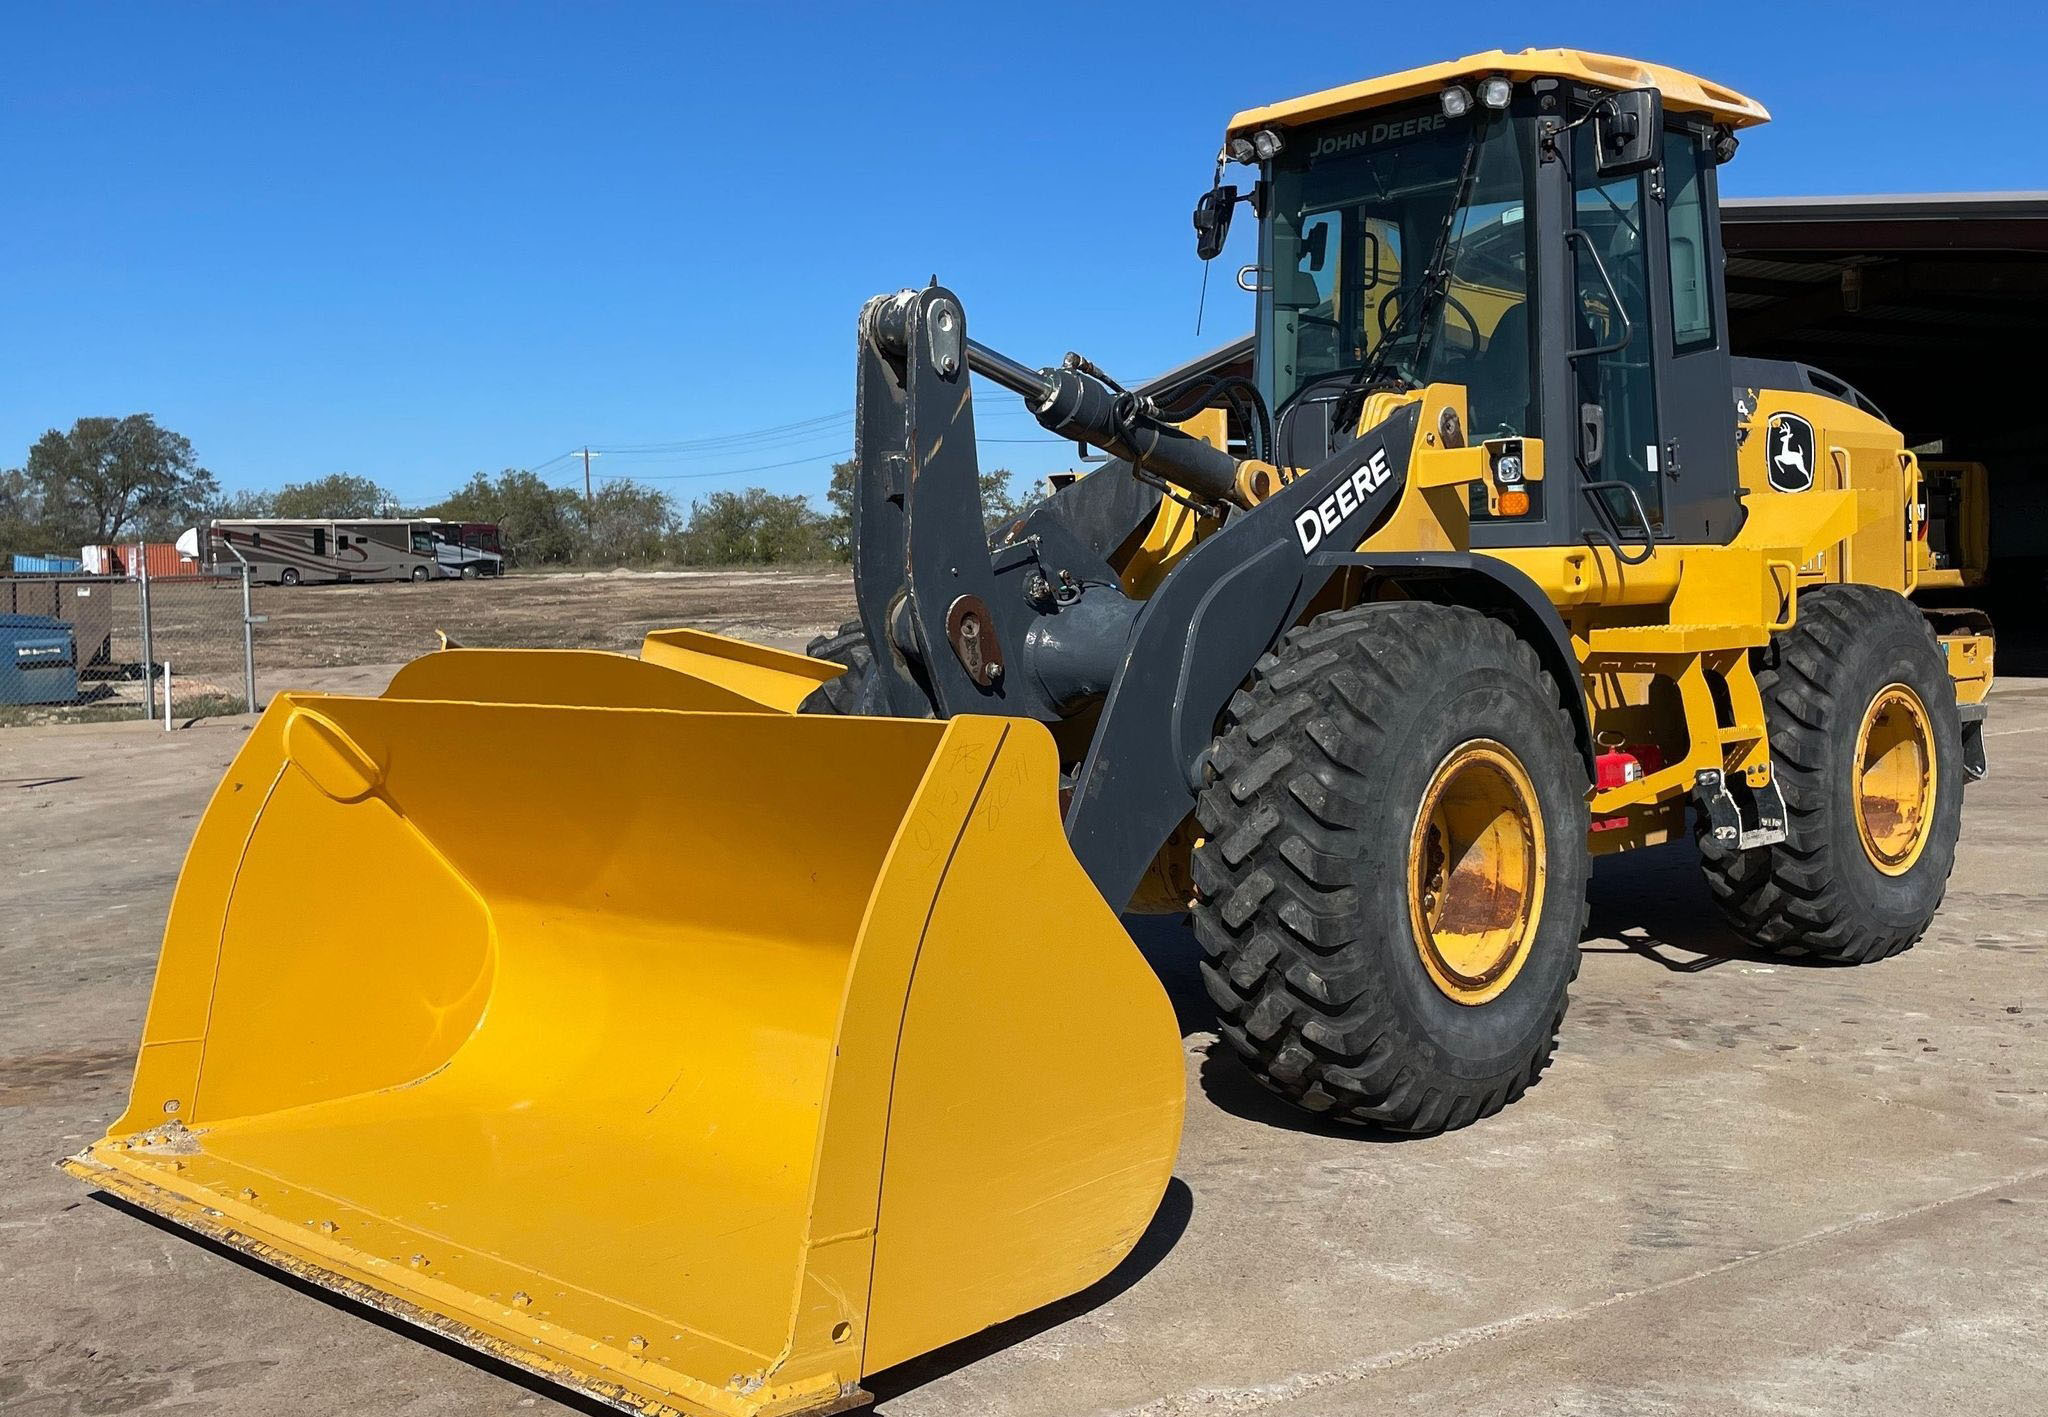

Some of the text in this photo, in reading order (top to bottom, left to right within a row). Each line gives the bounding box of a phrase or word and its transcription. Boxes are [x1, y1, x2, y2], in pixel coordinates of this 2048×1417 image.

[1310, 114, 1446, 157] JOHN DEERE
[1294, 447, 1392, 556] DEERE
